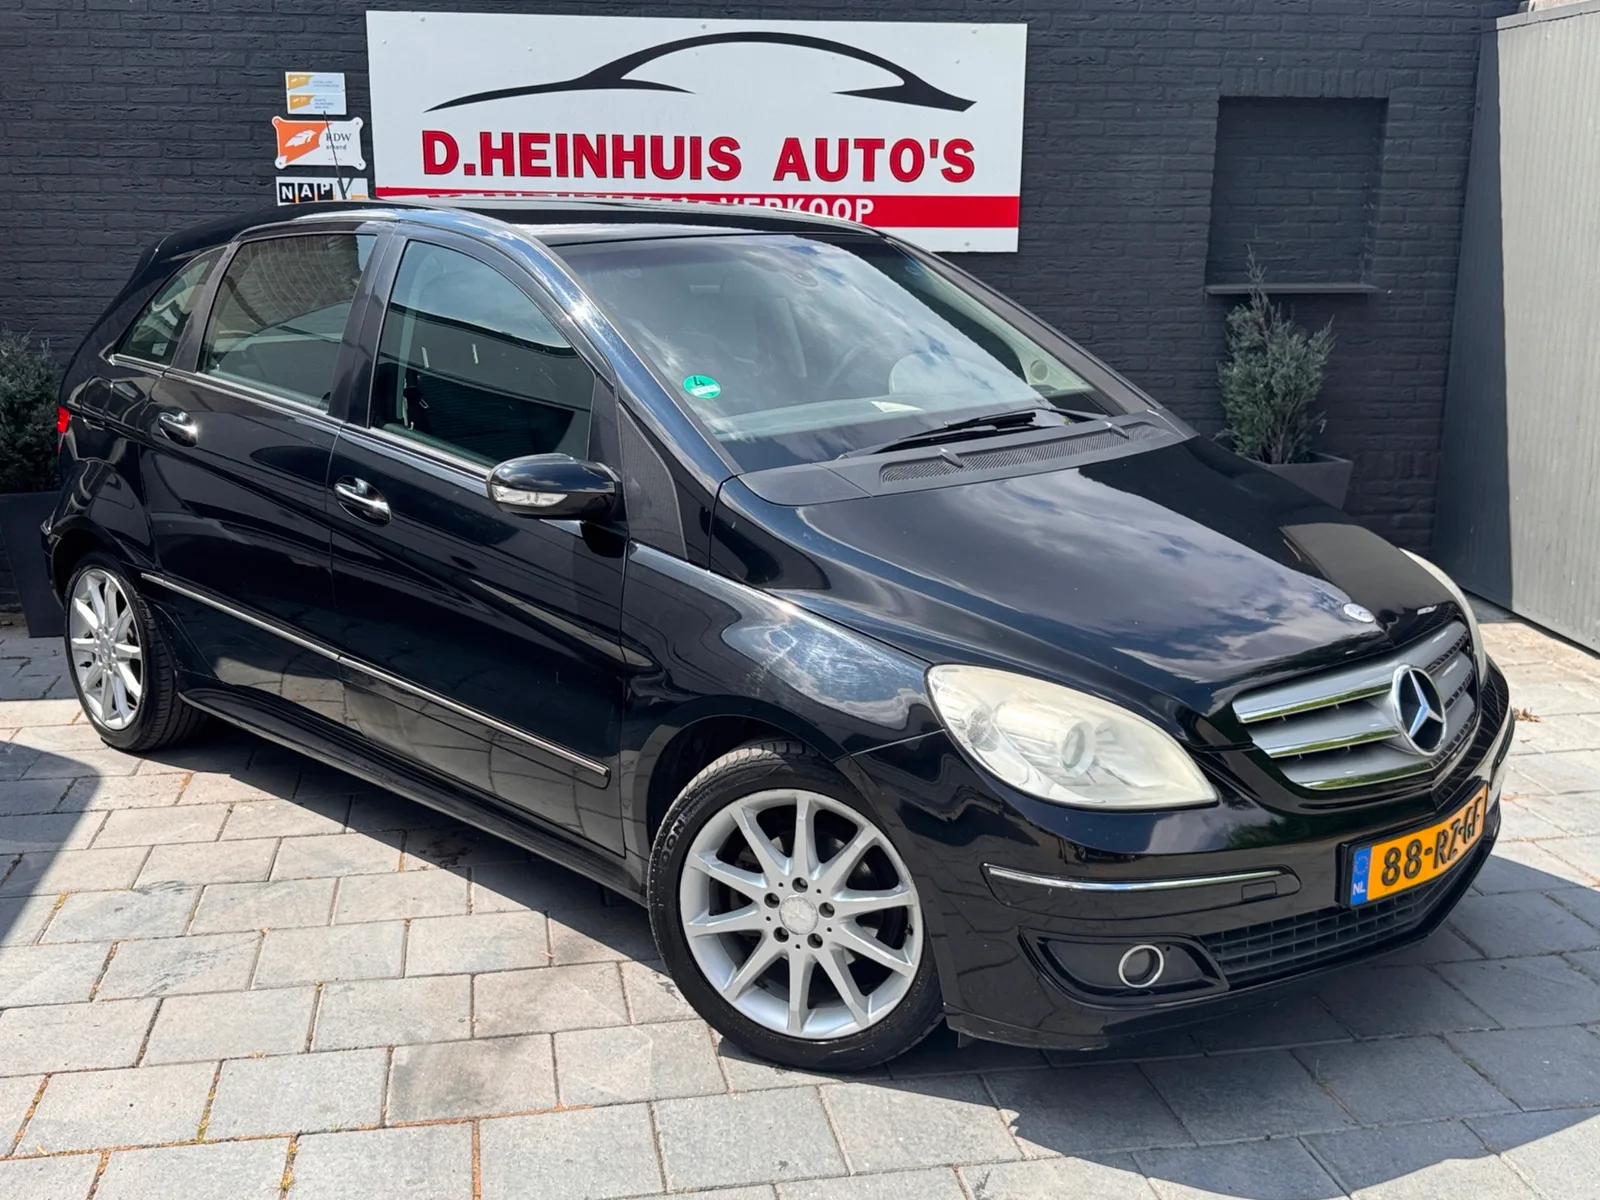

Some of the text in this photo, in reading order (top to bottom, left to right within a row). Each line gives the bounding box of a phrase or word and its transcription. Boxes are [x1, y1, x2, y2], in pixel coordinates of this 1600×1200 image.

[422, 130, 975, 183] D.HEINHUIS AUTO'S
[1352, 880, 1366, 895] NL
